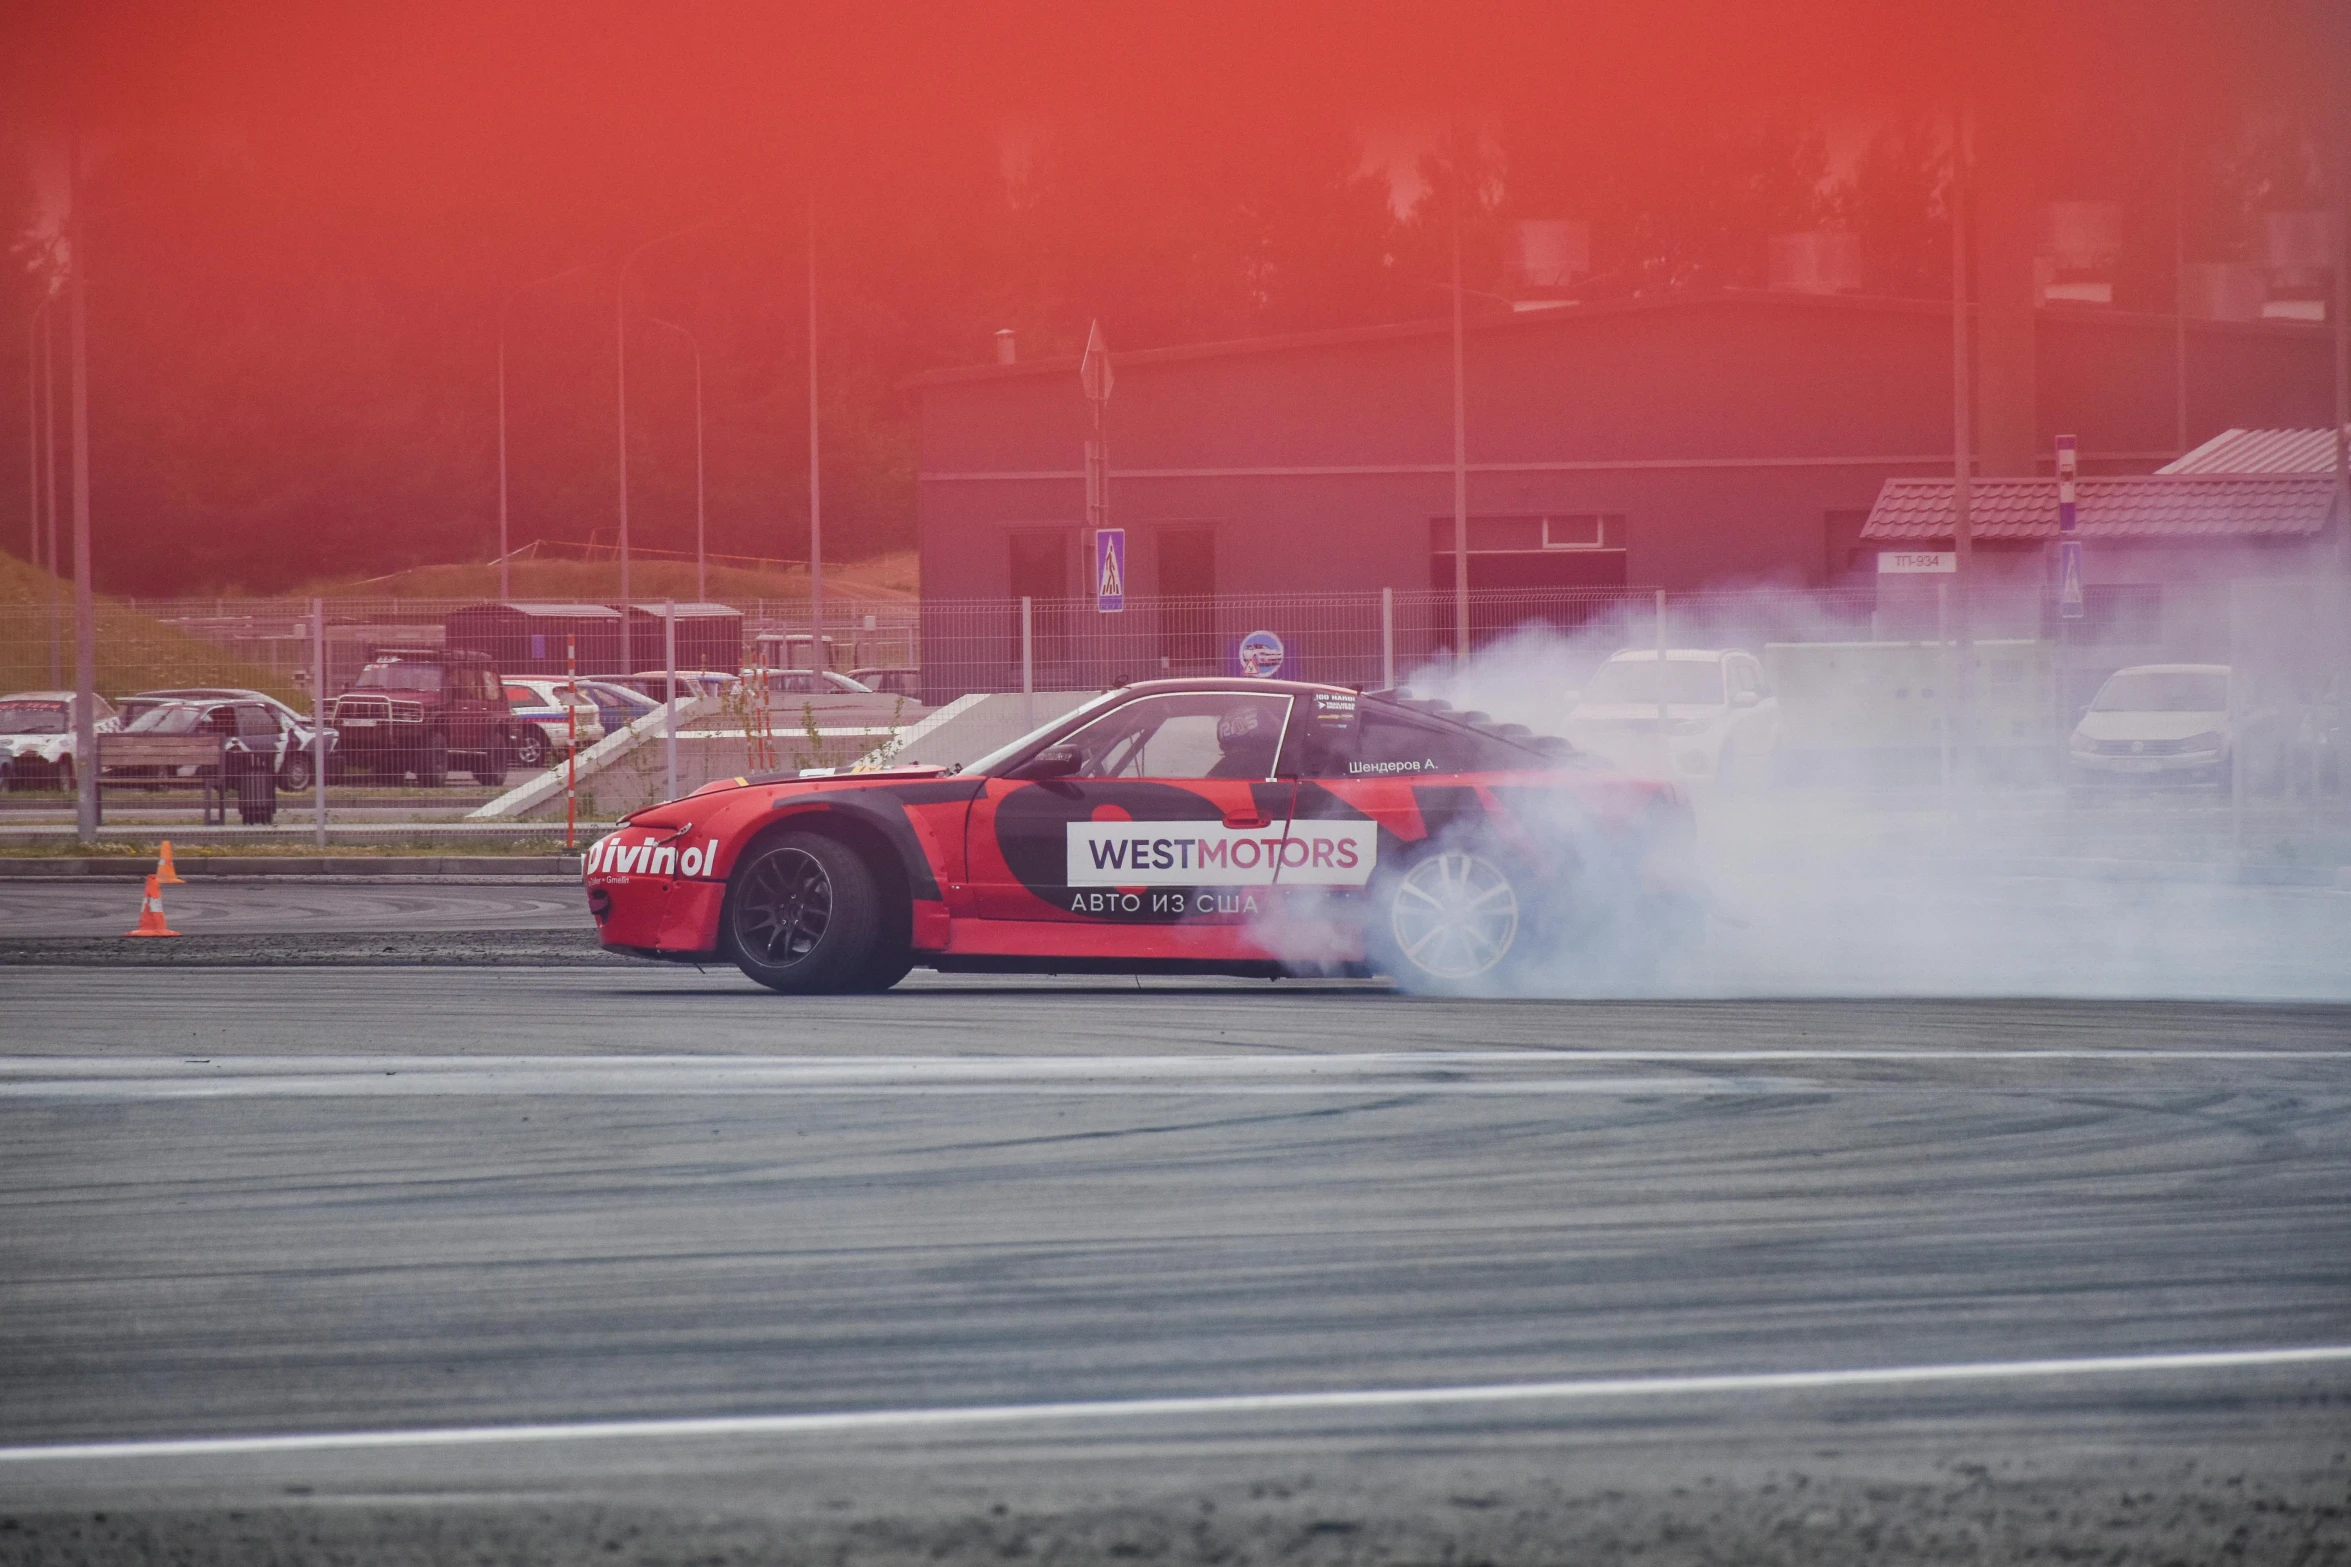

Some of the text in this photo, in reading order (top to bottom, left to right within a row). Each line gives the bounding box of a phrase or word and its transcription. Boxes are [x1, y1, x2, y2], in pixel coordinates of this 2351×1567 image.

[1893, 555, 1940, 567] ТП-934
[1349, 758, 1439, 774] Шендеров А.
[587, 836, 719, 877] Divinol
[1088, 837, 1359, 870] WESTMOTORS
[1071, 893, 1259, 915] АВТО ИЗ США
